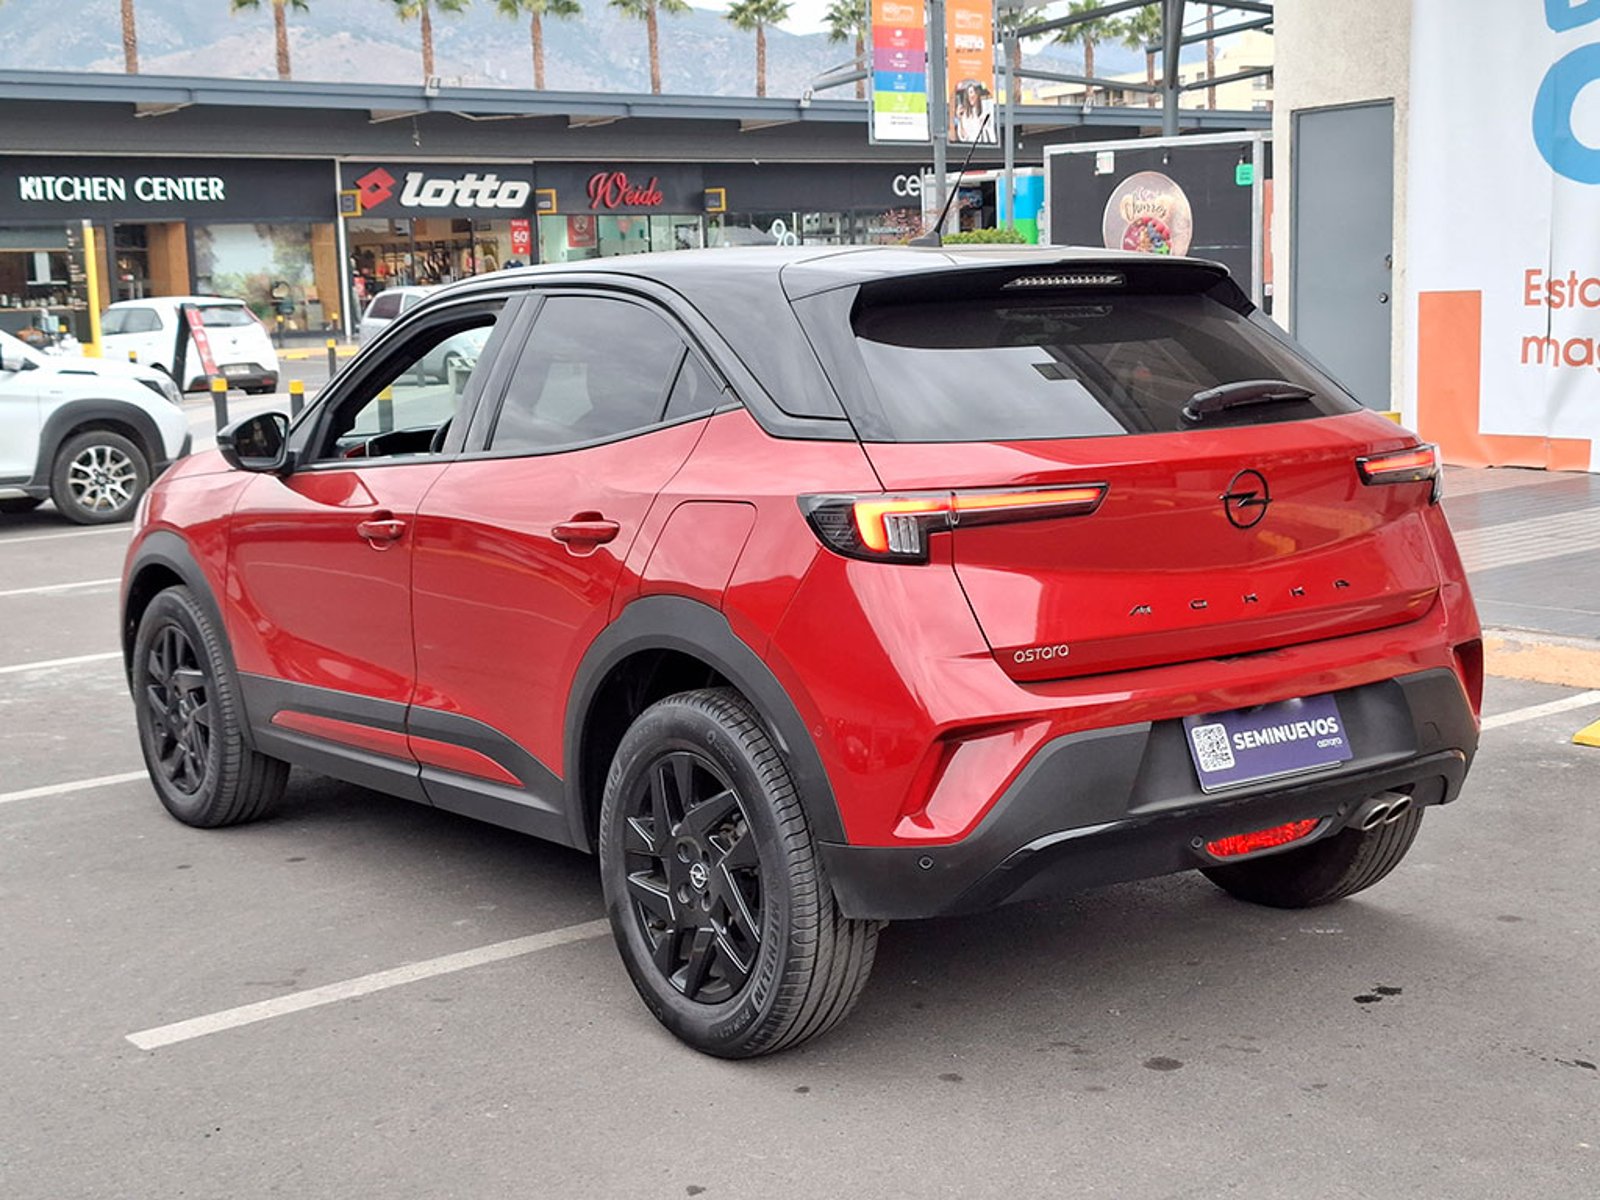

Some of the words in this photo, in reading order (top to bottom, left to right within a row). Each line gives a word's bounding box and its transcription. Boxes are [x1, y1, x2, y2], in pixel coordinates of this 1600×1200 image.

[19, 176, 126, 202] KITCHEN
[134, 176, 226, 202] CENTER
[400, 171, 531, 209] lotto
[587, 171, 664, 210] Weide
[1521, 336, 1600, 373] ma
[1013, 643, 1070, 664] astara
[1232, 716, 1340, 751] SEMINUEVOS
